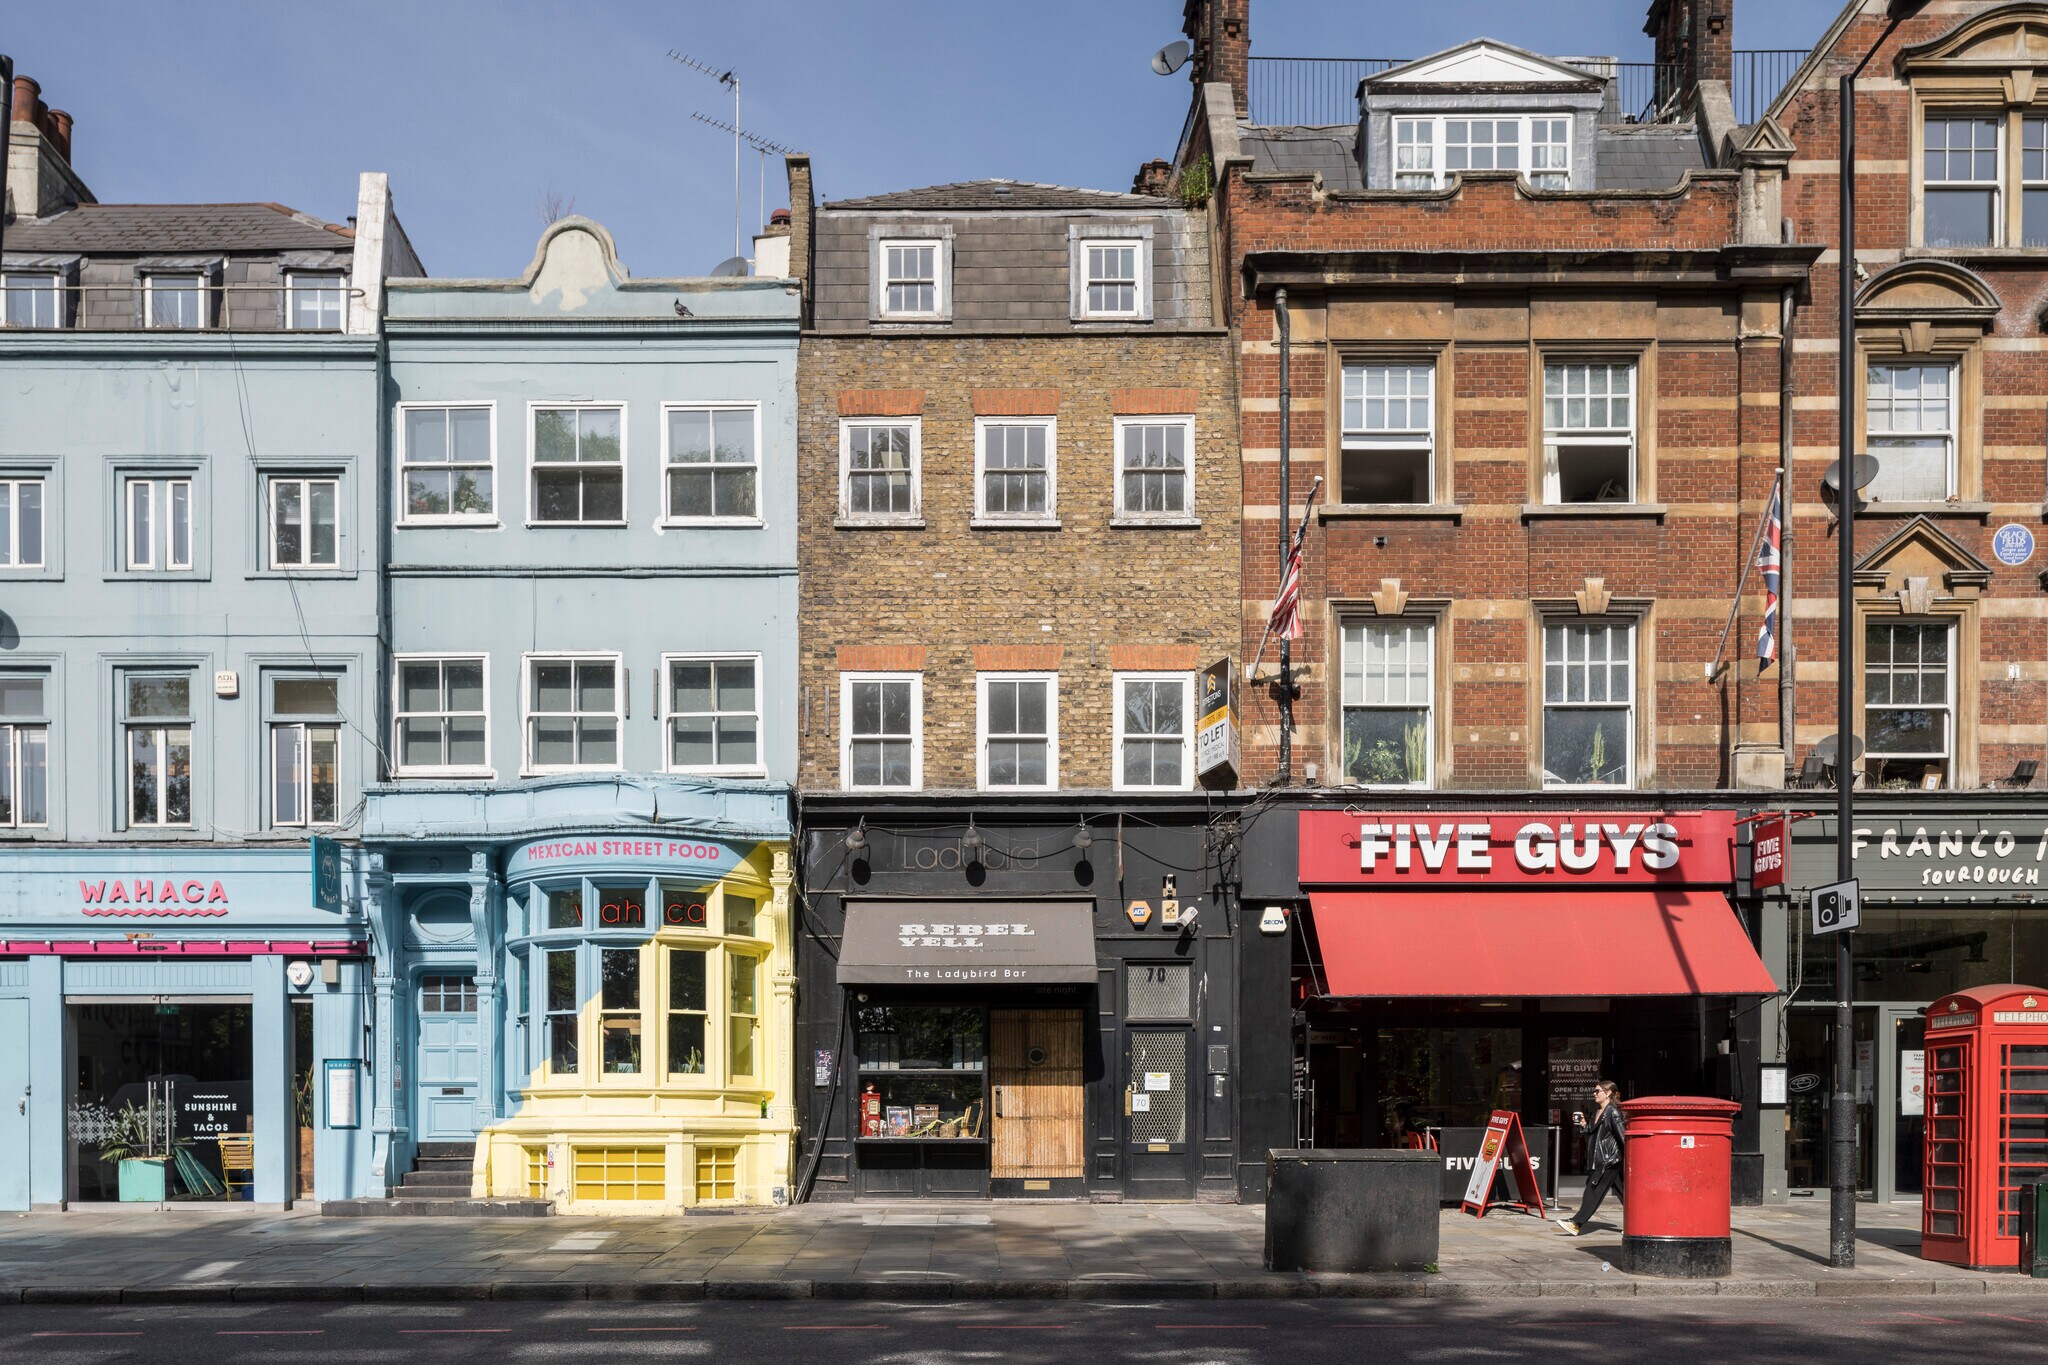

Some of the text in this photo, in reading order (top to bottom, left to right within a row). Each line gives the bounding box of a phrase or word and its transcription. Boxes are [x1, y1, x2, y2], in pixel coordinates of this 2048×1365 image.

[1199, 723, 1225, 749] TO LET
[528, 840, 720, 860] MEXICAN STREET FOOD
[1361, 822, 1680, 870] FIVE GUYS
[1757, 836, 1780, 857] FIVE
[1852, 826, 2016, 860] FRANCO
[1754, 852, 1782, 873] GUYS
[1922, 865, 2039, 885] SOURDOUGH
[79, 880, 228, 903] WAHACA
[899, 924, 1035, 936] REBEL
[899, 937, 984, 947] YELL
[907, 969, 1027, 980] The Ladybird Bar
[1147, 967, 1166, 983] 70
[184, 1103, 237, 1112] SUNSHINE
[1135, 1098, 1147, 1107] 70
[207, 1113, 215, 1122] &
[193, 1123, 229, 1132] TACOS
[1446, 1157, 1477, 1170] FIV
